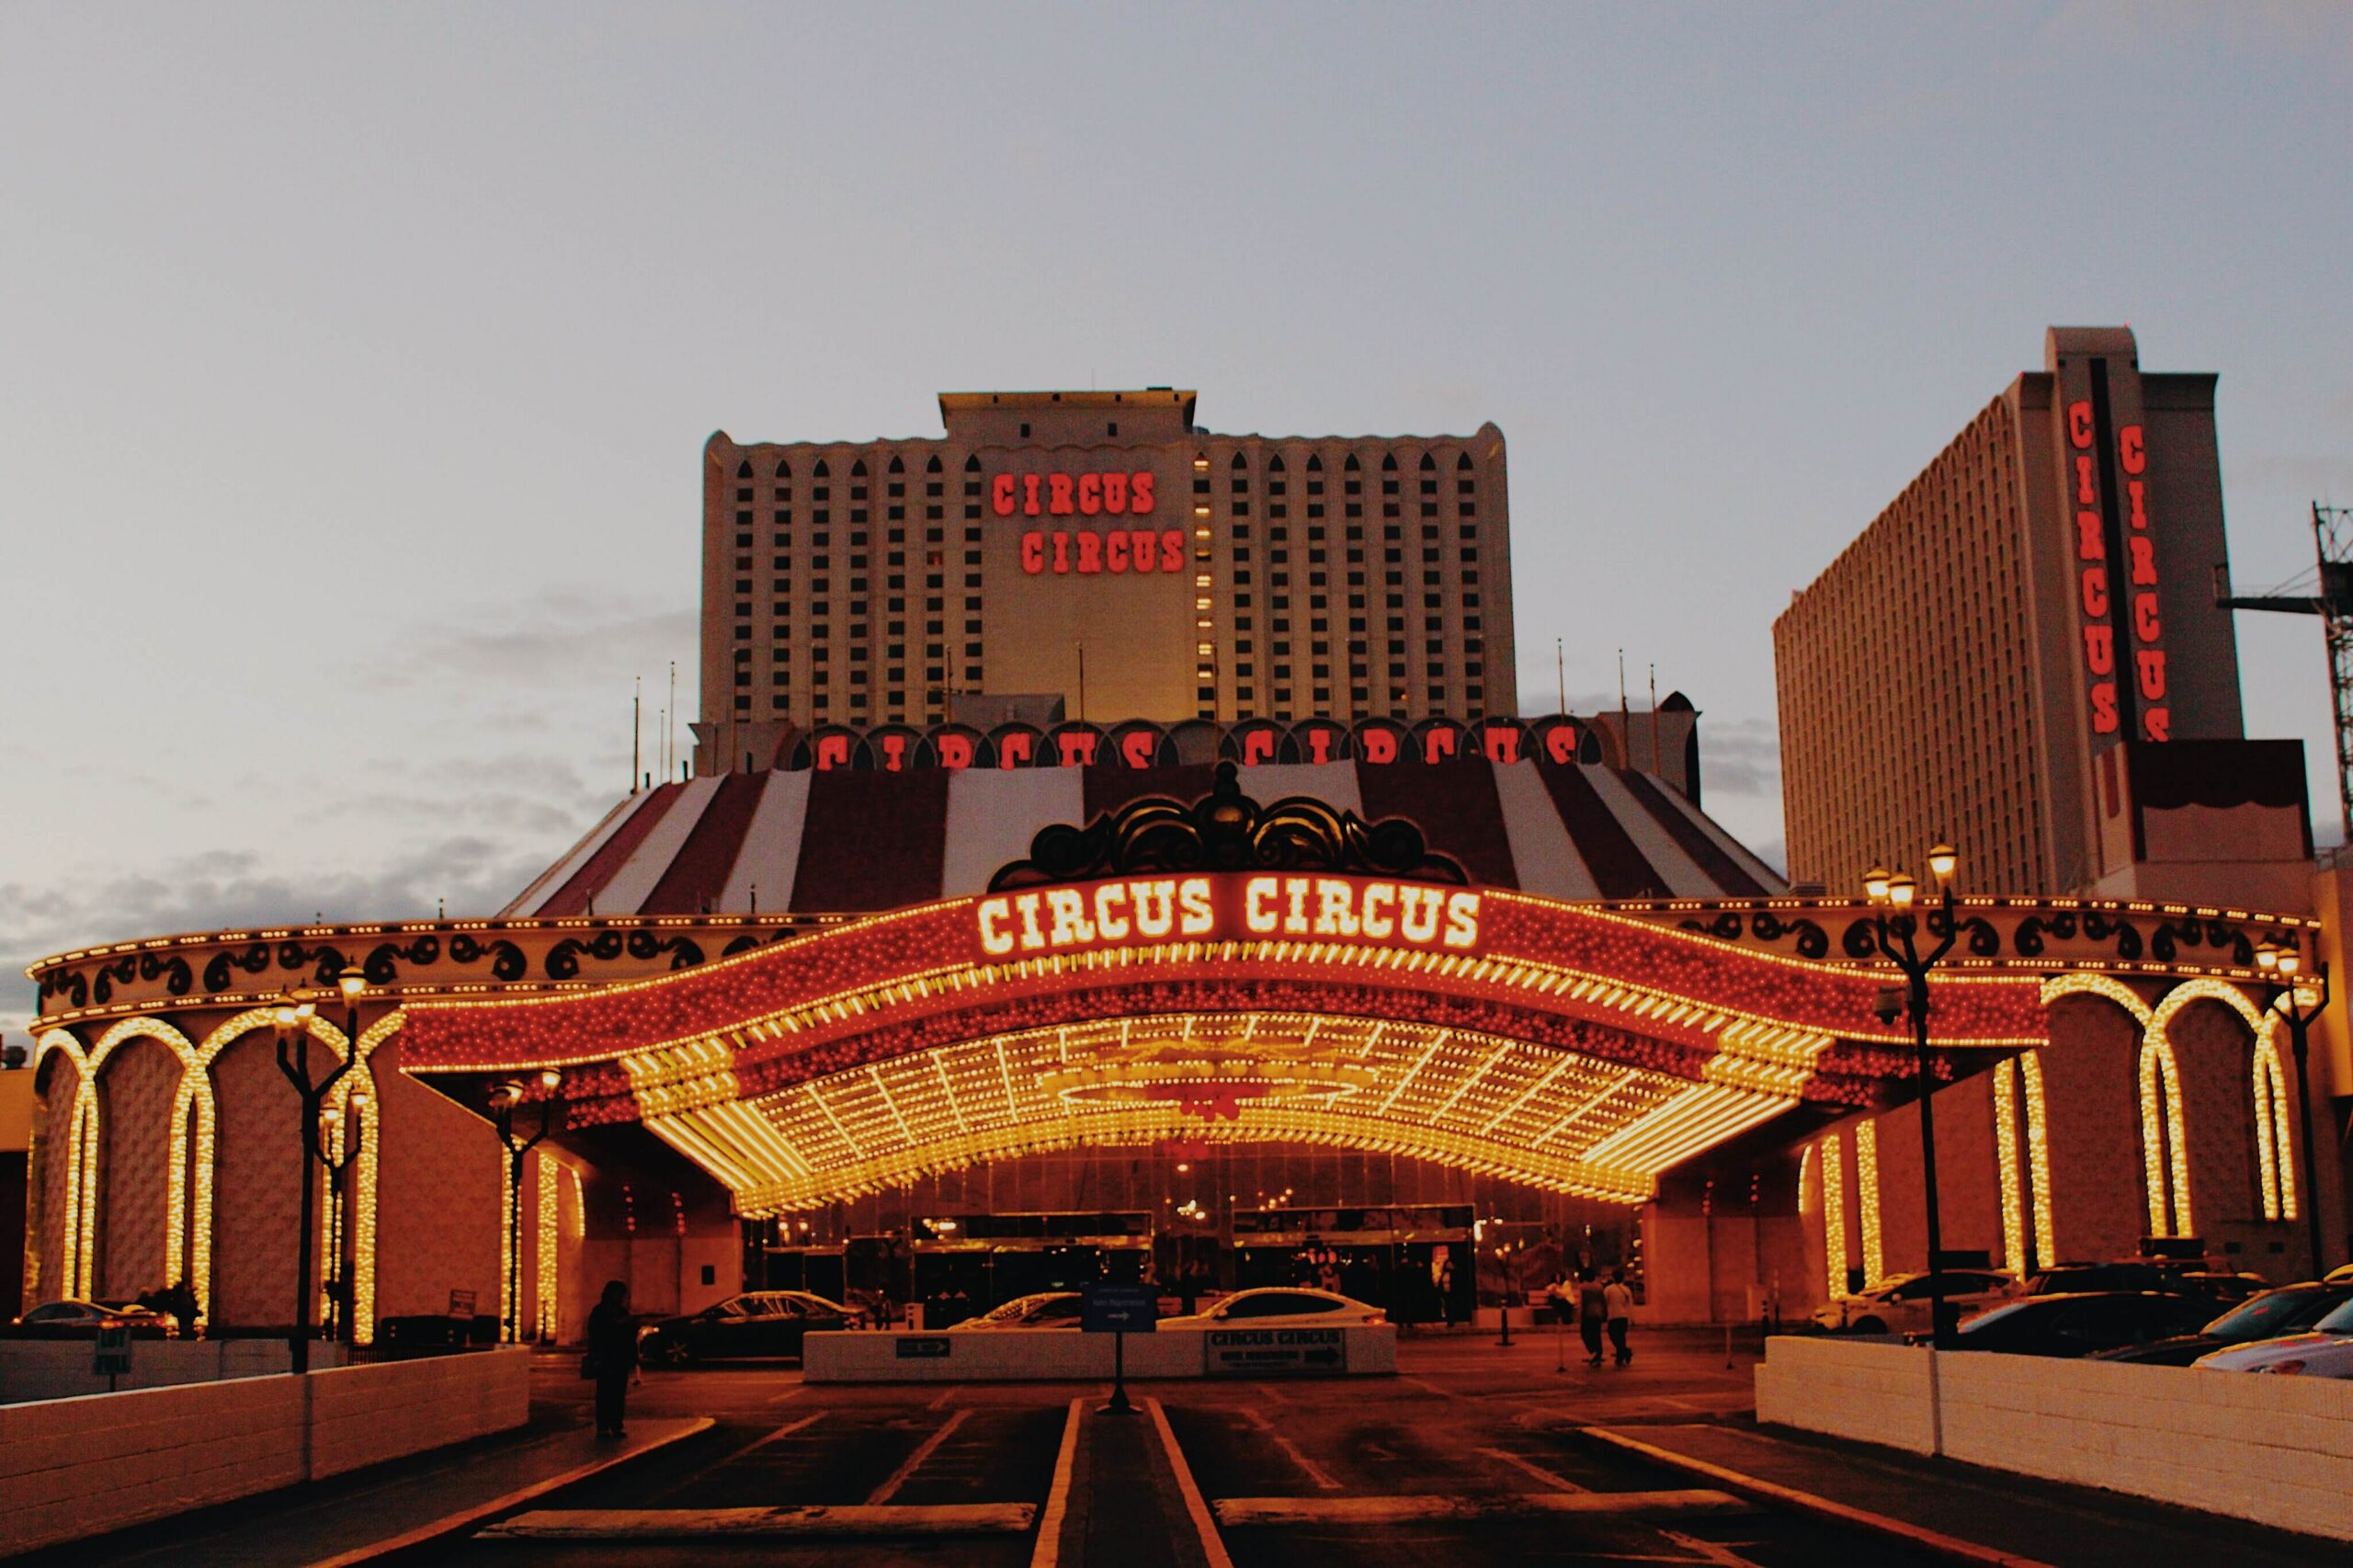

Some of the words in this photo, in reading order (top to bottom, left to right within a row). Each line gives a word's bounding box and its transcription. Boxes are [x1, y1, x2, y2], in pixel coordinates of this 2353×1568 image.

[993, 472, 1154, 516] CIRCUS
[1021, 530, 1185, 574] CIRCUS
[2069, 400, 2118, 733] CIRCUS
[2120, 425, 2170, 742] CIRCUS
[977, 879, 1214, 955] CIRCUS
[1245, 877, 1481, 949] CIRCUS
[1211, 1332, 1273, 1346] CIRCUS
[1277, 1331, 1339, 1345] CIRCUS
